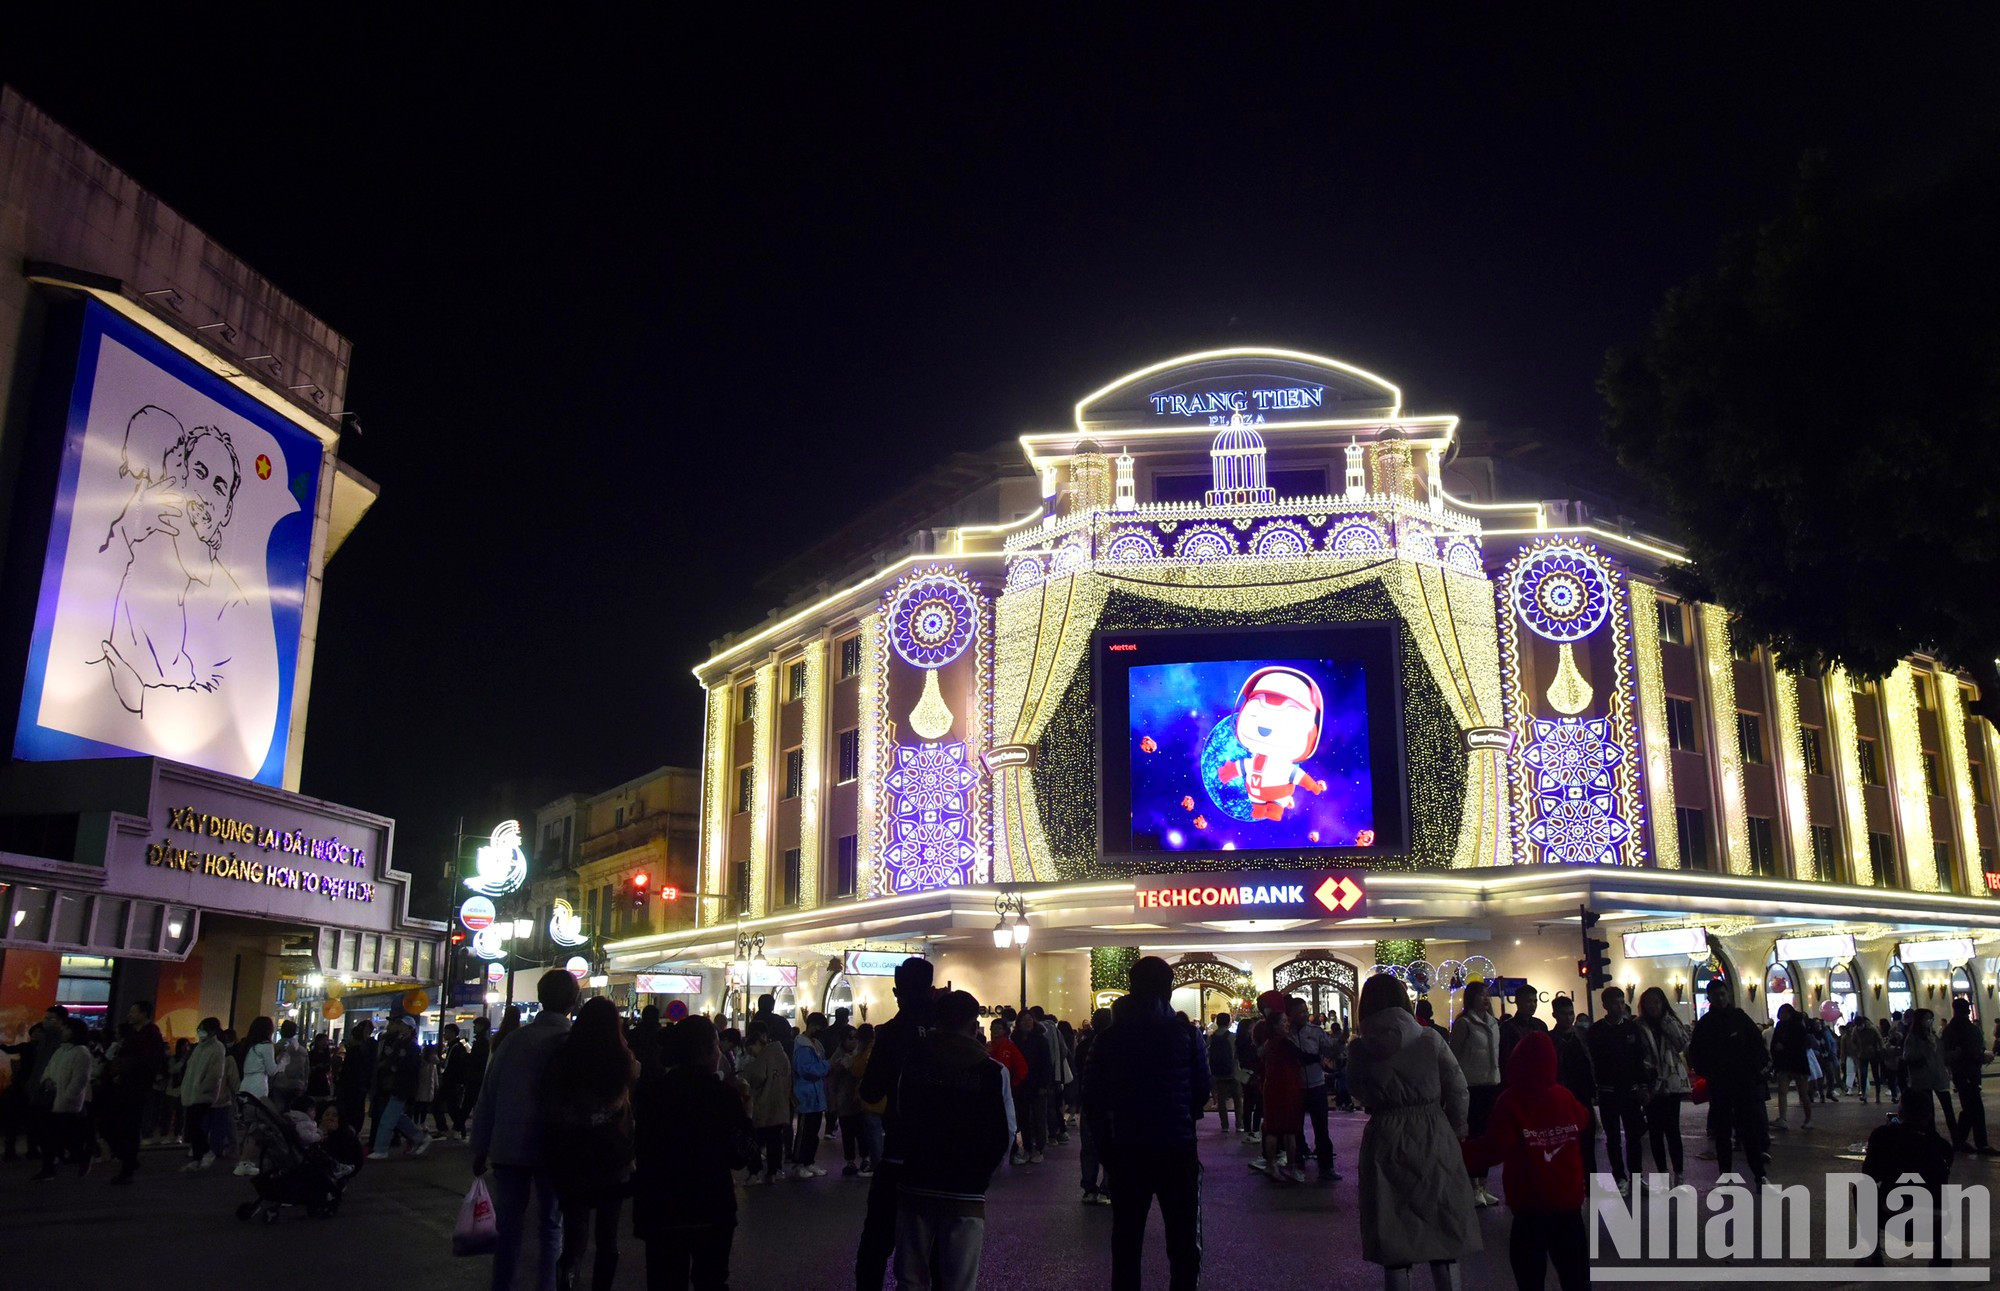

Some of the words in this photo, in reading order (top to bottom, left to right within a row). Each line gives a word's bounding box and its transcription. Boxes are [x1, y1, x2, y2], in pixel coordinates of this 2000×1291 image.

[1150, 391, 1247, 416] TRANG
[1252, 387, 1323, 409] TIEN
[1208, 414, 1266, 427] PLZA
[171, 806, 207, 834] XÂY
[258, 826, 279, 852] LẠI
[352, 848, 367, 868] TA
[266, 865, 299, 890] HƠN
[301, 871, 319, 893] TO
[320, 876, 346, 901] ĐẸP
[347, 881, 376, 902] HƠN
[662, 887, 676, 900] 23
[1136, 885, 1304, 908] TECHCOMBANK
